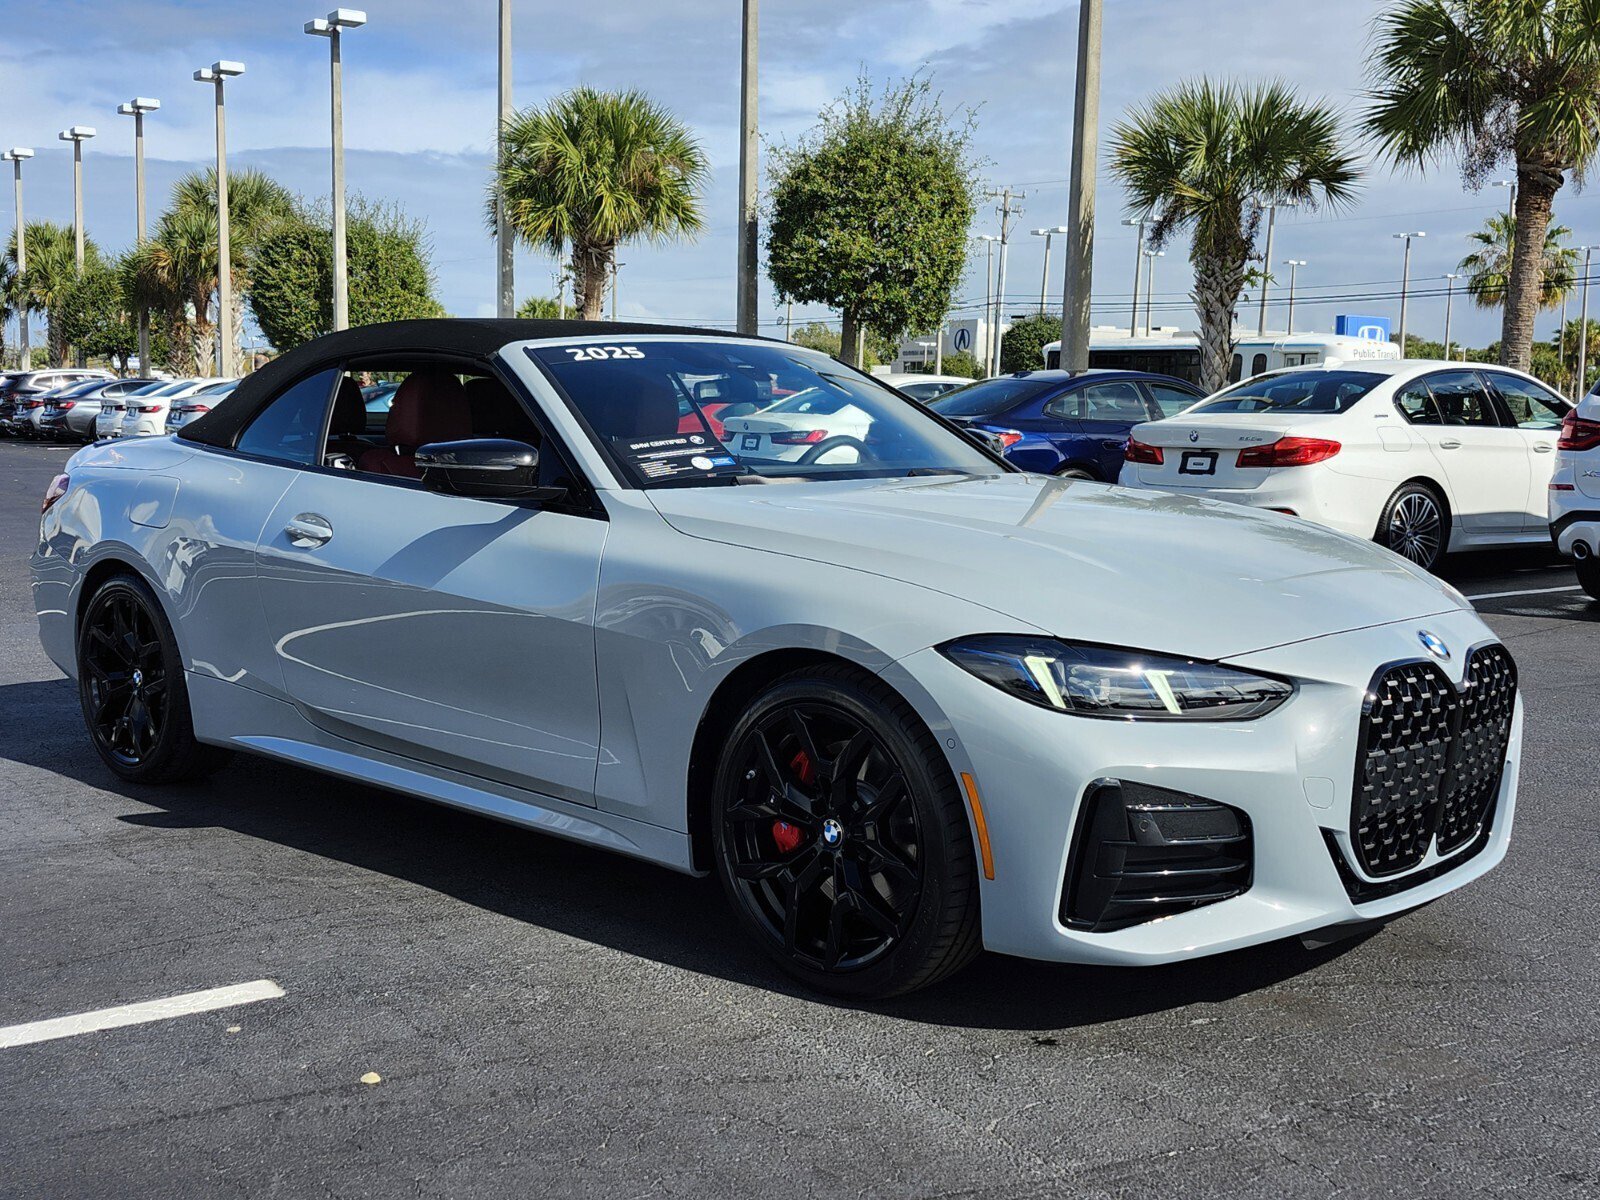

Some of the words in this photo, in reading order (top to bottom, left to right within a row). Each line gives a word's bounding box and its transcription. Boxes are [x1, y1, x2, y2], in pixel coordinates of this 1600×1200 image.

[565, 346, 646, 361] 2025
[1353, 349, 1376, 358] Public
[1377, 350, 1398, 360] Transit
[650, 438, 687, 447] CERTIFIED
